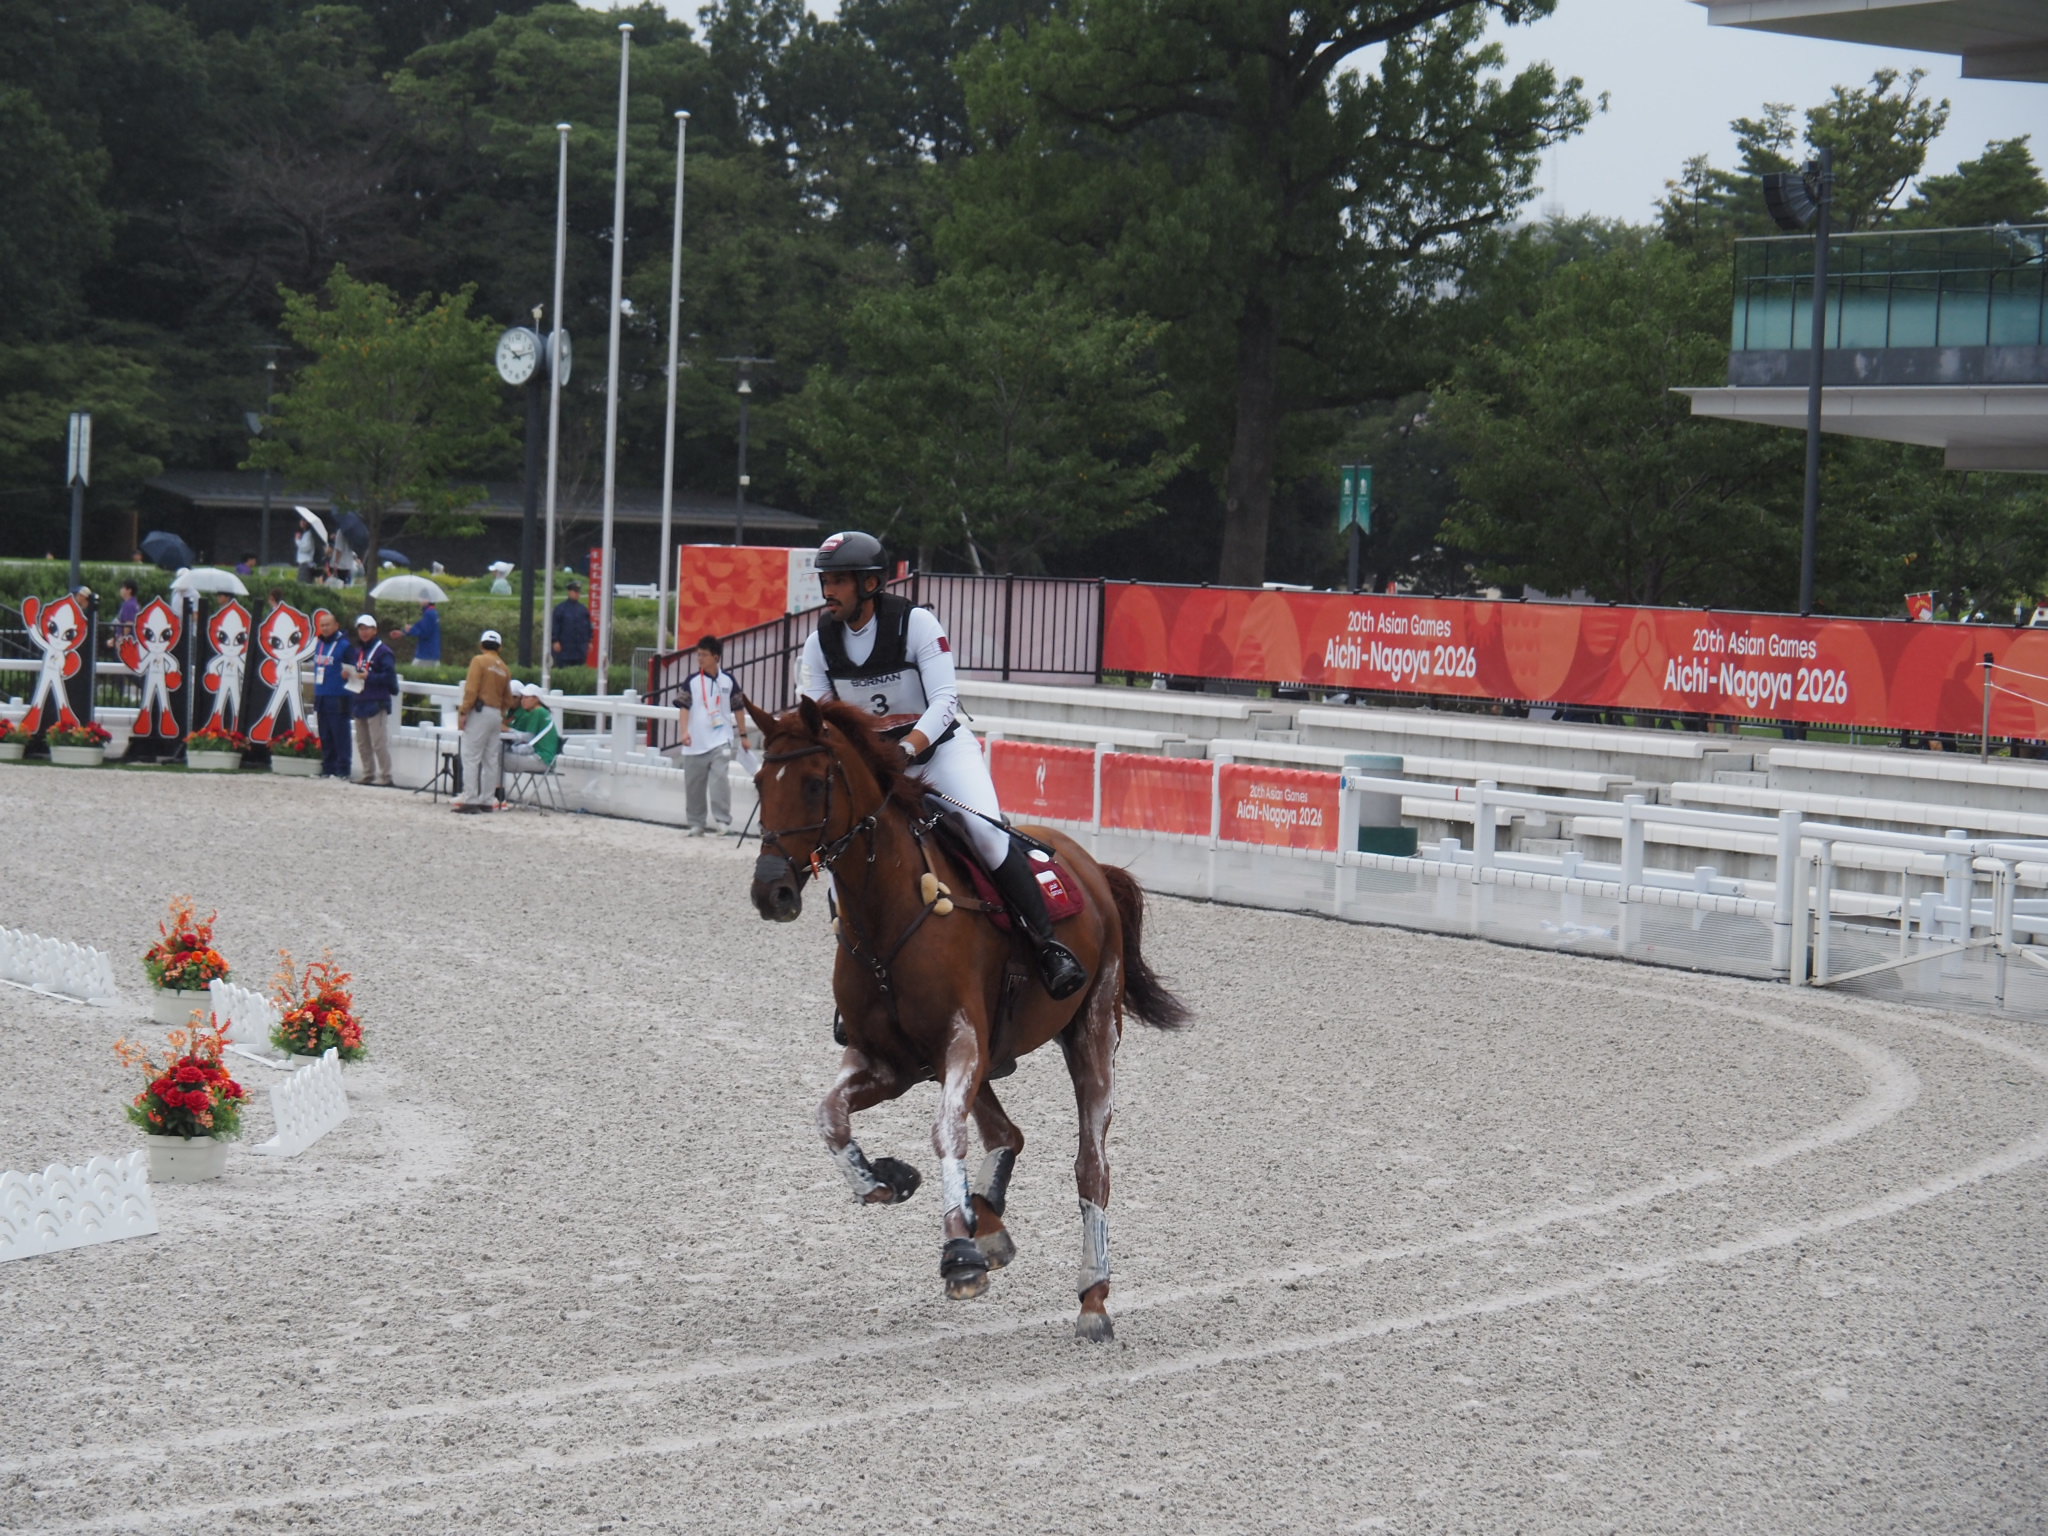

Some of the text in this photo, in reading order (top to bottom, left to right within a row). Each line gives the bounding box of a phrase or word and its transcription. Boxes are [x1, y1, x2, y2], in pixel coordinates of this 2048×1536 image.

[1347, 610, 1451, 638] 20th Asian Games
[1692, 628, 1817, 659] 20th Asian Games
[1324, 636, 1477, 683] Aichi-Nagoya 2026
[1663, 655, 1848, 710] Aichi-Nagoya 2026
[871, 694, 889, 716] 3
[1250, 784, 1308, 802] 20th Asian Games
[1237, 800, 1322, 829] Aichi-Nagoya 2026
